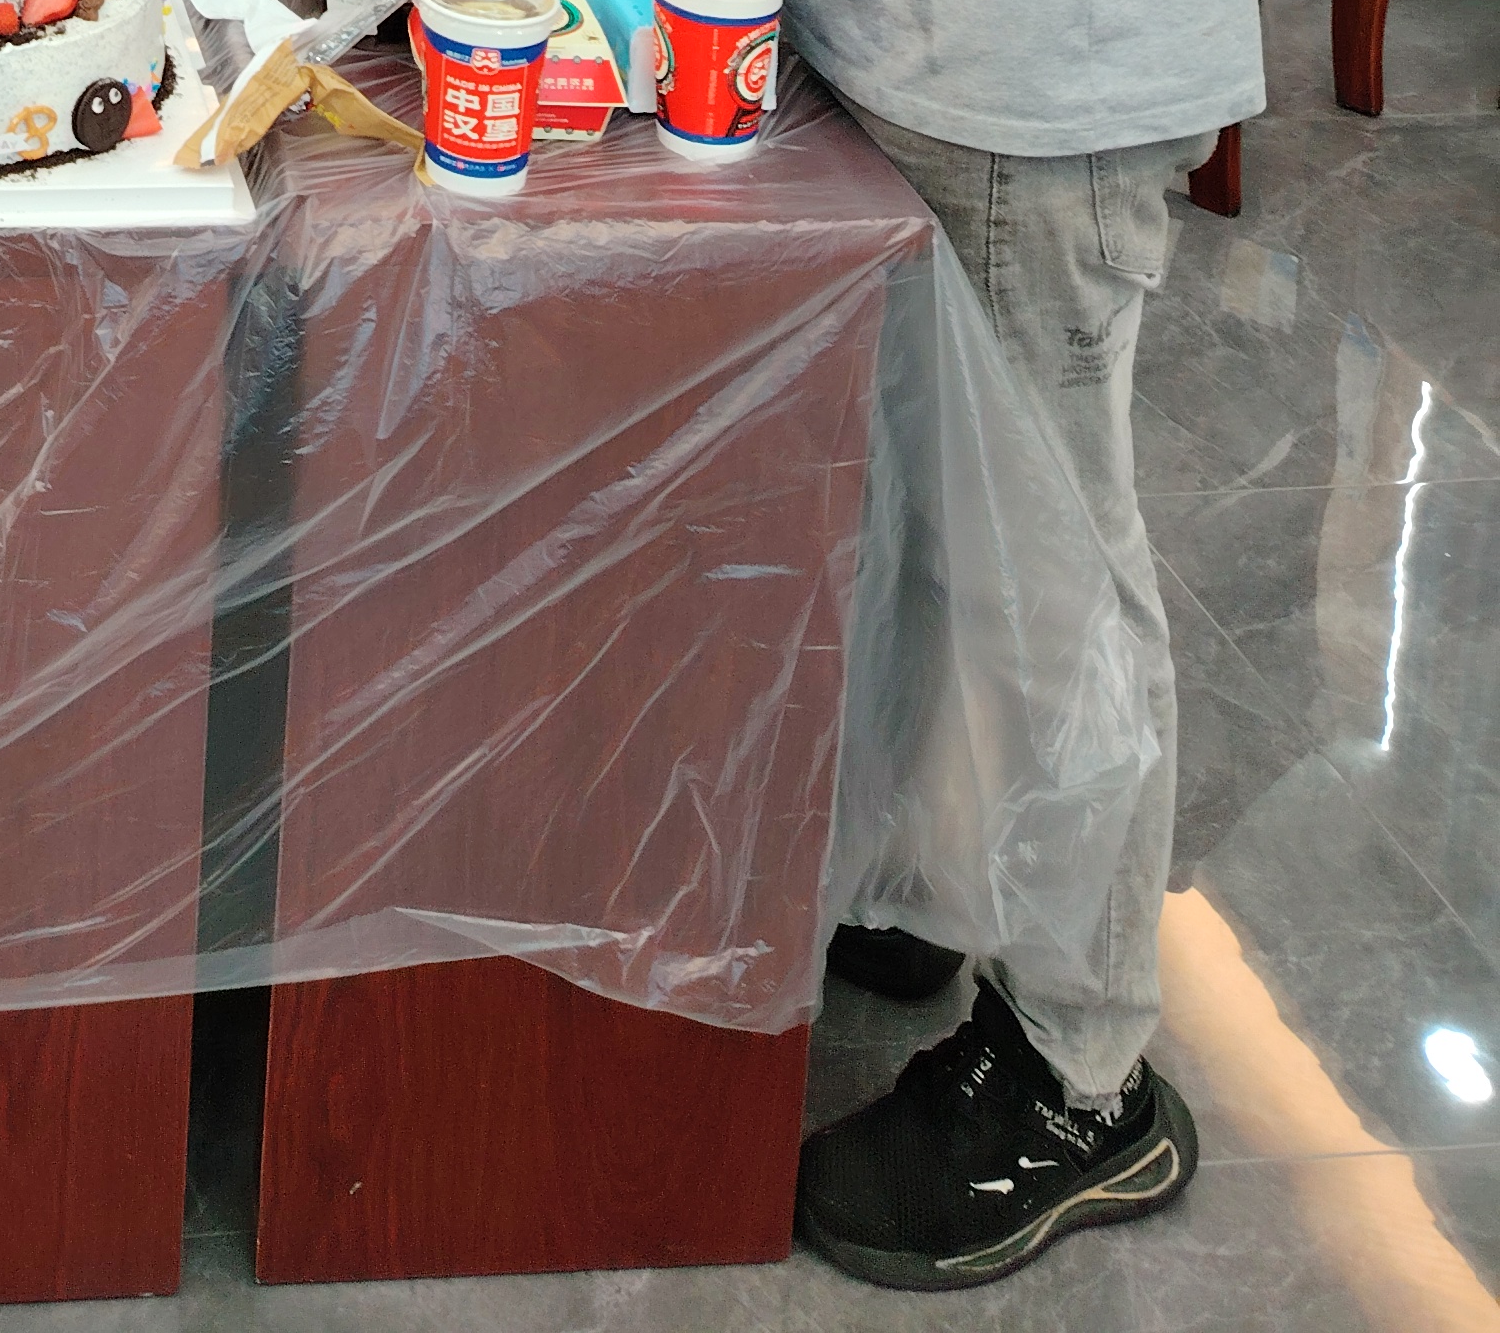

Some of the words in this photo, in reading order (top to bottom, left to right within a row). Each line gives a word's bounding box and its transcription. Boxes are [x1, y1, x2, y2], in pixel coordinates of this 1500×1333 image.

[446, 75, 476, 90] MADE
[478, 84, 490, 92] IN
[492, 83, 522, 92] CHINA
[445, 88, 520, 117] 中国
[443, 109, 518, 142] 汉堡
